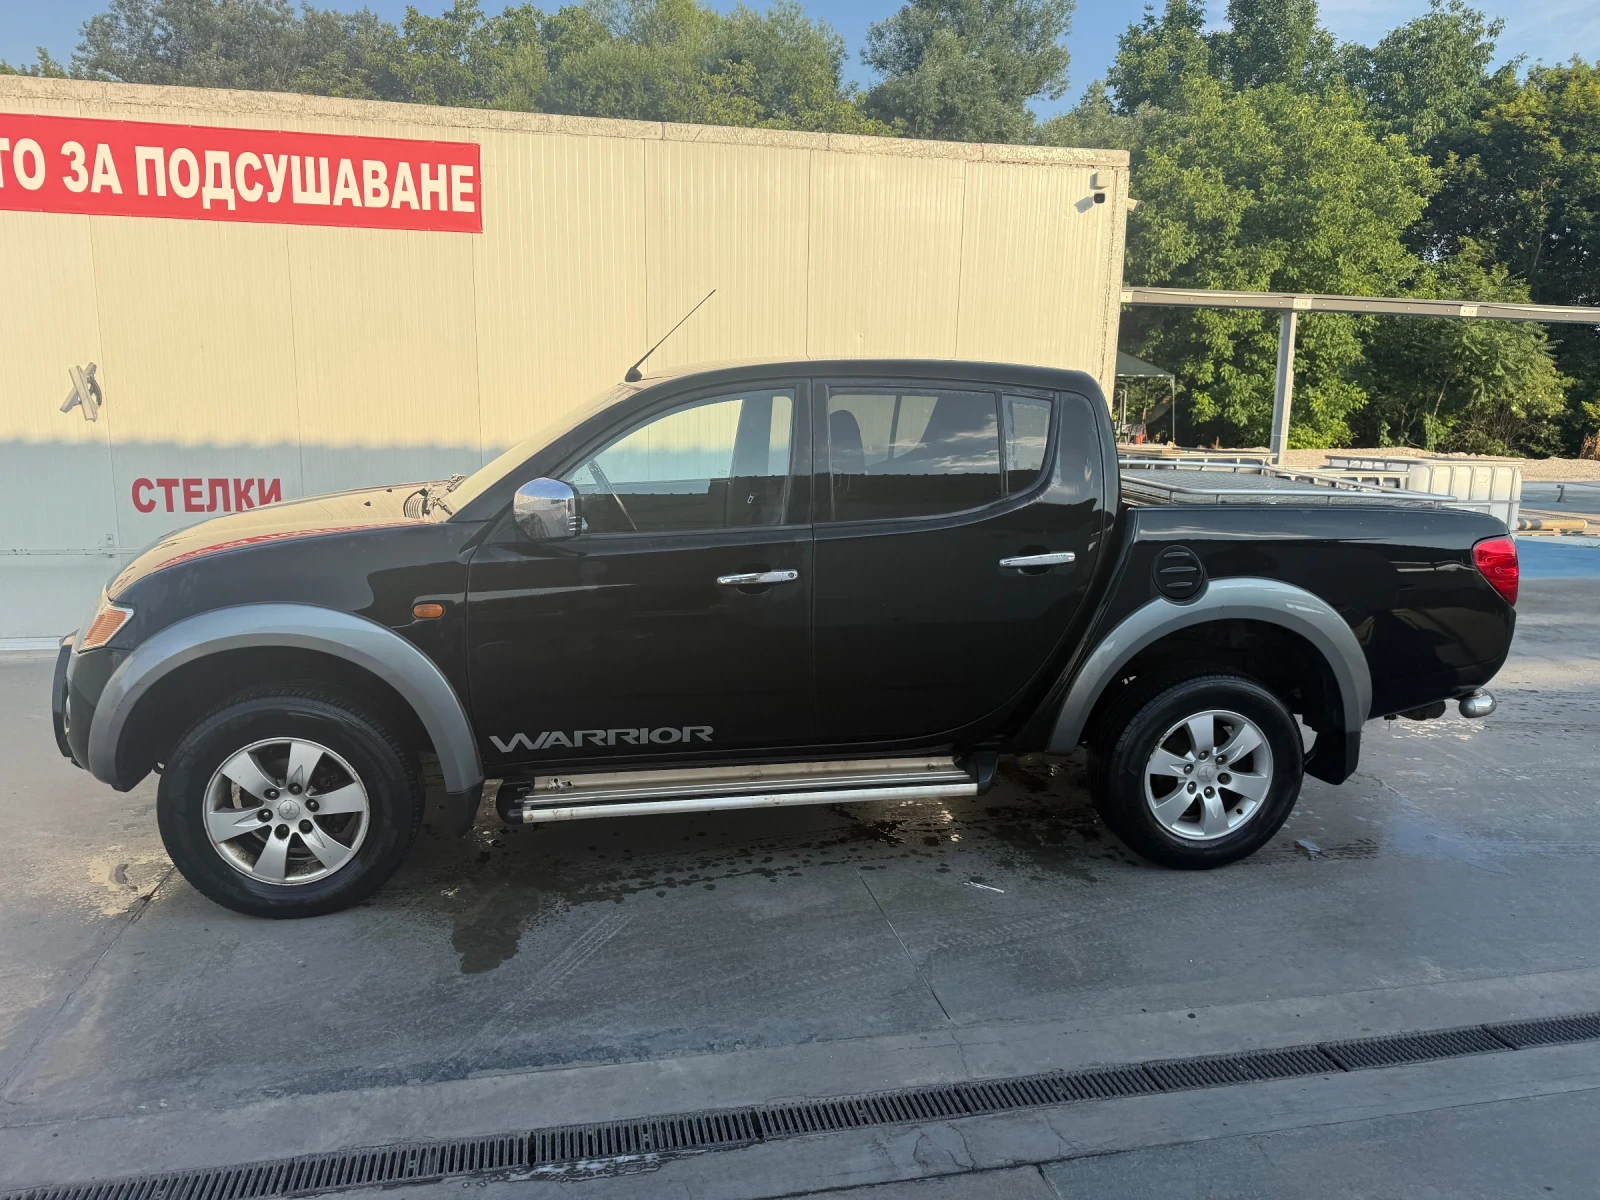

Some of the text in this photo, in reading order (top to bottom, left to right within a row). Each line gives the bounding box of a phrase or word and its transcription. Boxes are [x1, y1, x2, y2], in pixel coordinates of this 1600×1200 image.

[61, 140, 123, 195] ЗА
[135, 145, 476, 213] ПОДСУШАВАНЕ
[132, 478, 282, 513] СТЕЛКИ
[489, 725, 714, 753] WARRIOR
